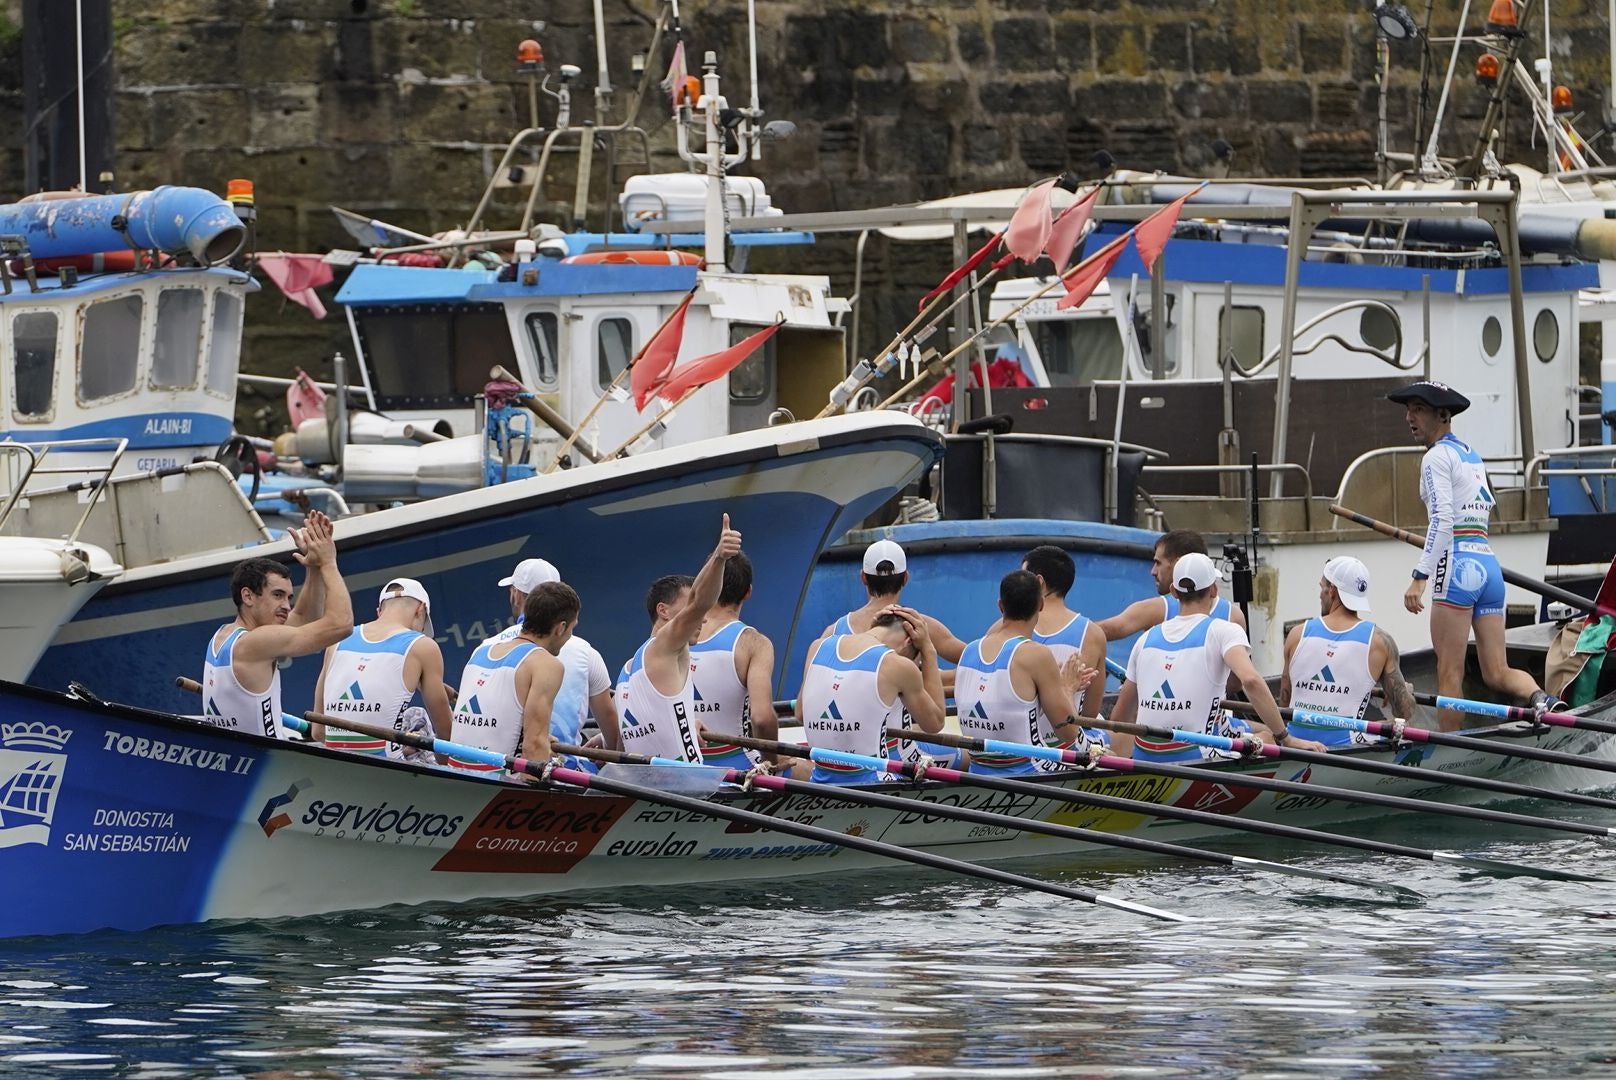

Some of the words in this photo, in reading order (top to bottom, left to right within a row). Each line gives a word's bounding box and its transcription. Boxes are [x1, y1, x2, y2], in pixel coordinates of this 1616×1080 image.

[144, 418, 192, 435] ALAIN-BI
[1295, 680, 1350, 695] AMENABAR
[326, 702, 381, 713] AMENABAR
[694, 702, 721, 713] ABAR
[1140, 699, 1192, 711] AMENABAR
[1294, 701, 1339, 712] URKIROLAK
[263, 700, 275, 736] DRU
[808, 721, 861, 732] AMENABAR
[1314, 715, 1358, 730] CaixaBank
[1029, 709, 1041, 747] DRU
[103, 730, 232, 772] TORREKUA
[232, 755, 256, 776] II
[93, 809, 174, 829] DONOSTIA
[302, 799, 464, 838] serviobras
[63, 833, 101, 851] SAN
[100, 831, 191, 853] SEBASTIÁN
[314, 827, 436, 846] DONOSTI
[475, 835, 579, 854] comunica
